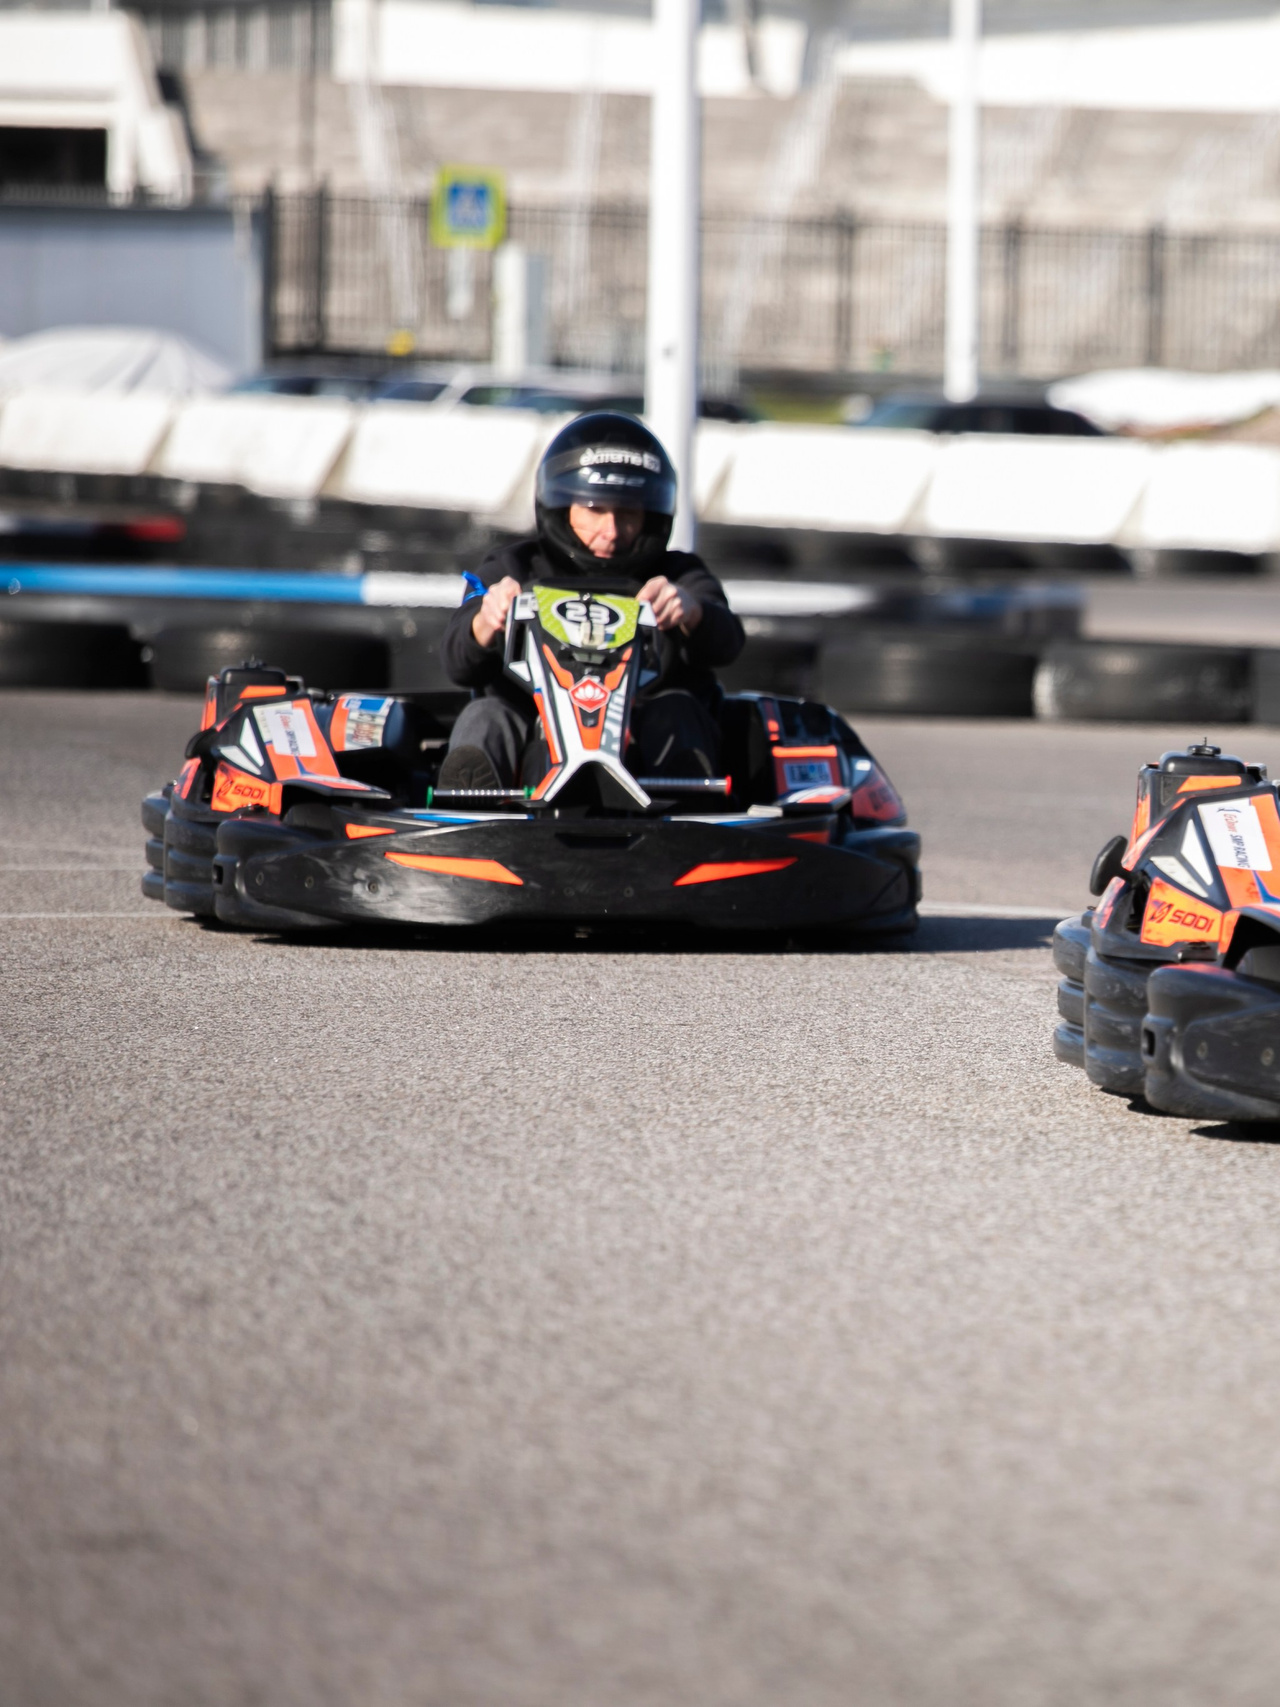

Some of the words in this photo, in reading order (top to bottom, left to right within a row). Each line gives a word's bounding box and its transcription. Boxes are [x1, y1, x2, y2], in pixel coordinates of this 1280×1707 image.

[565, 602, 610, 625] 23
[232, 783, 265, 800] SODI
[1169, 909, 1214, 932] SODI
